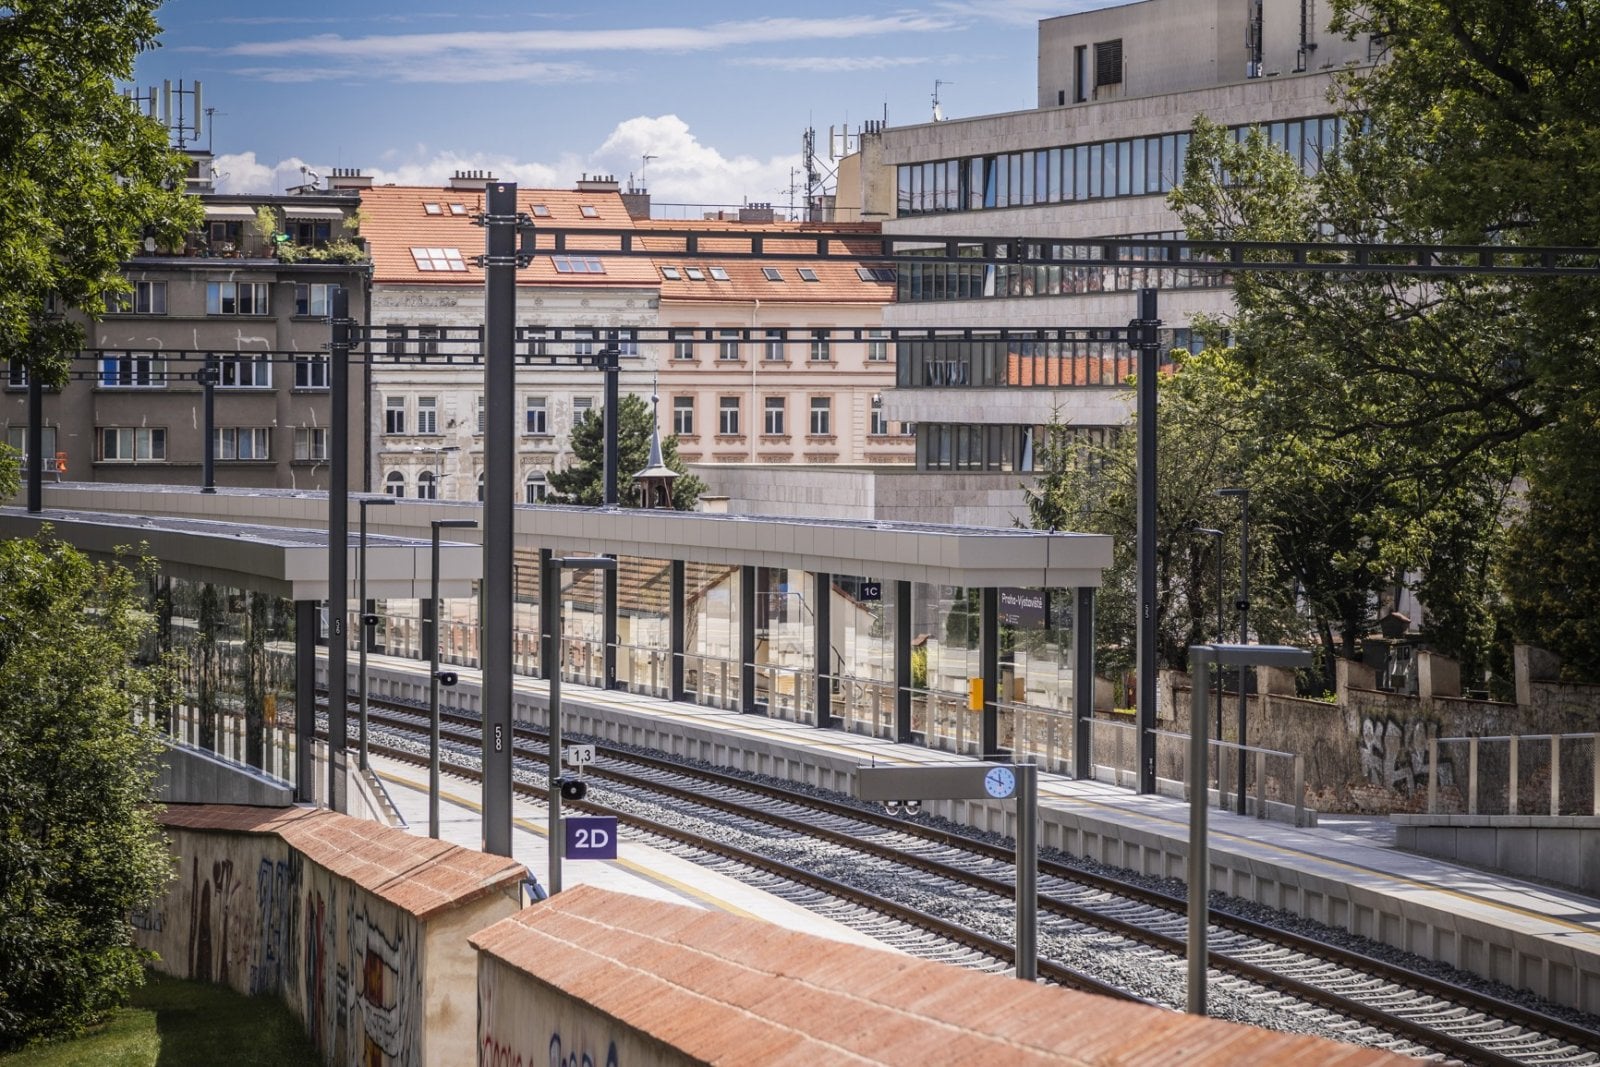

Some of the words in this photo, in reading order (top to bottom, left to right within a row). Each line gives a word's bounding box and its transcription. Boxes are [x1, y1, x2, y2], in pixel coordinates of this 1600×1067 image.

[864, 587, 878, 596] 1C
[495, 726, 502, 750] 58
[574, 749, 591, 764] 1,3
[575, 829, 609, 848] 2D
